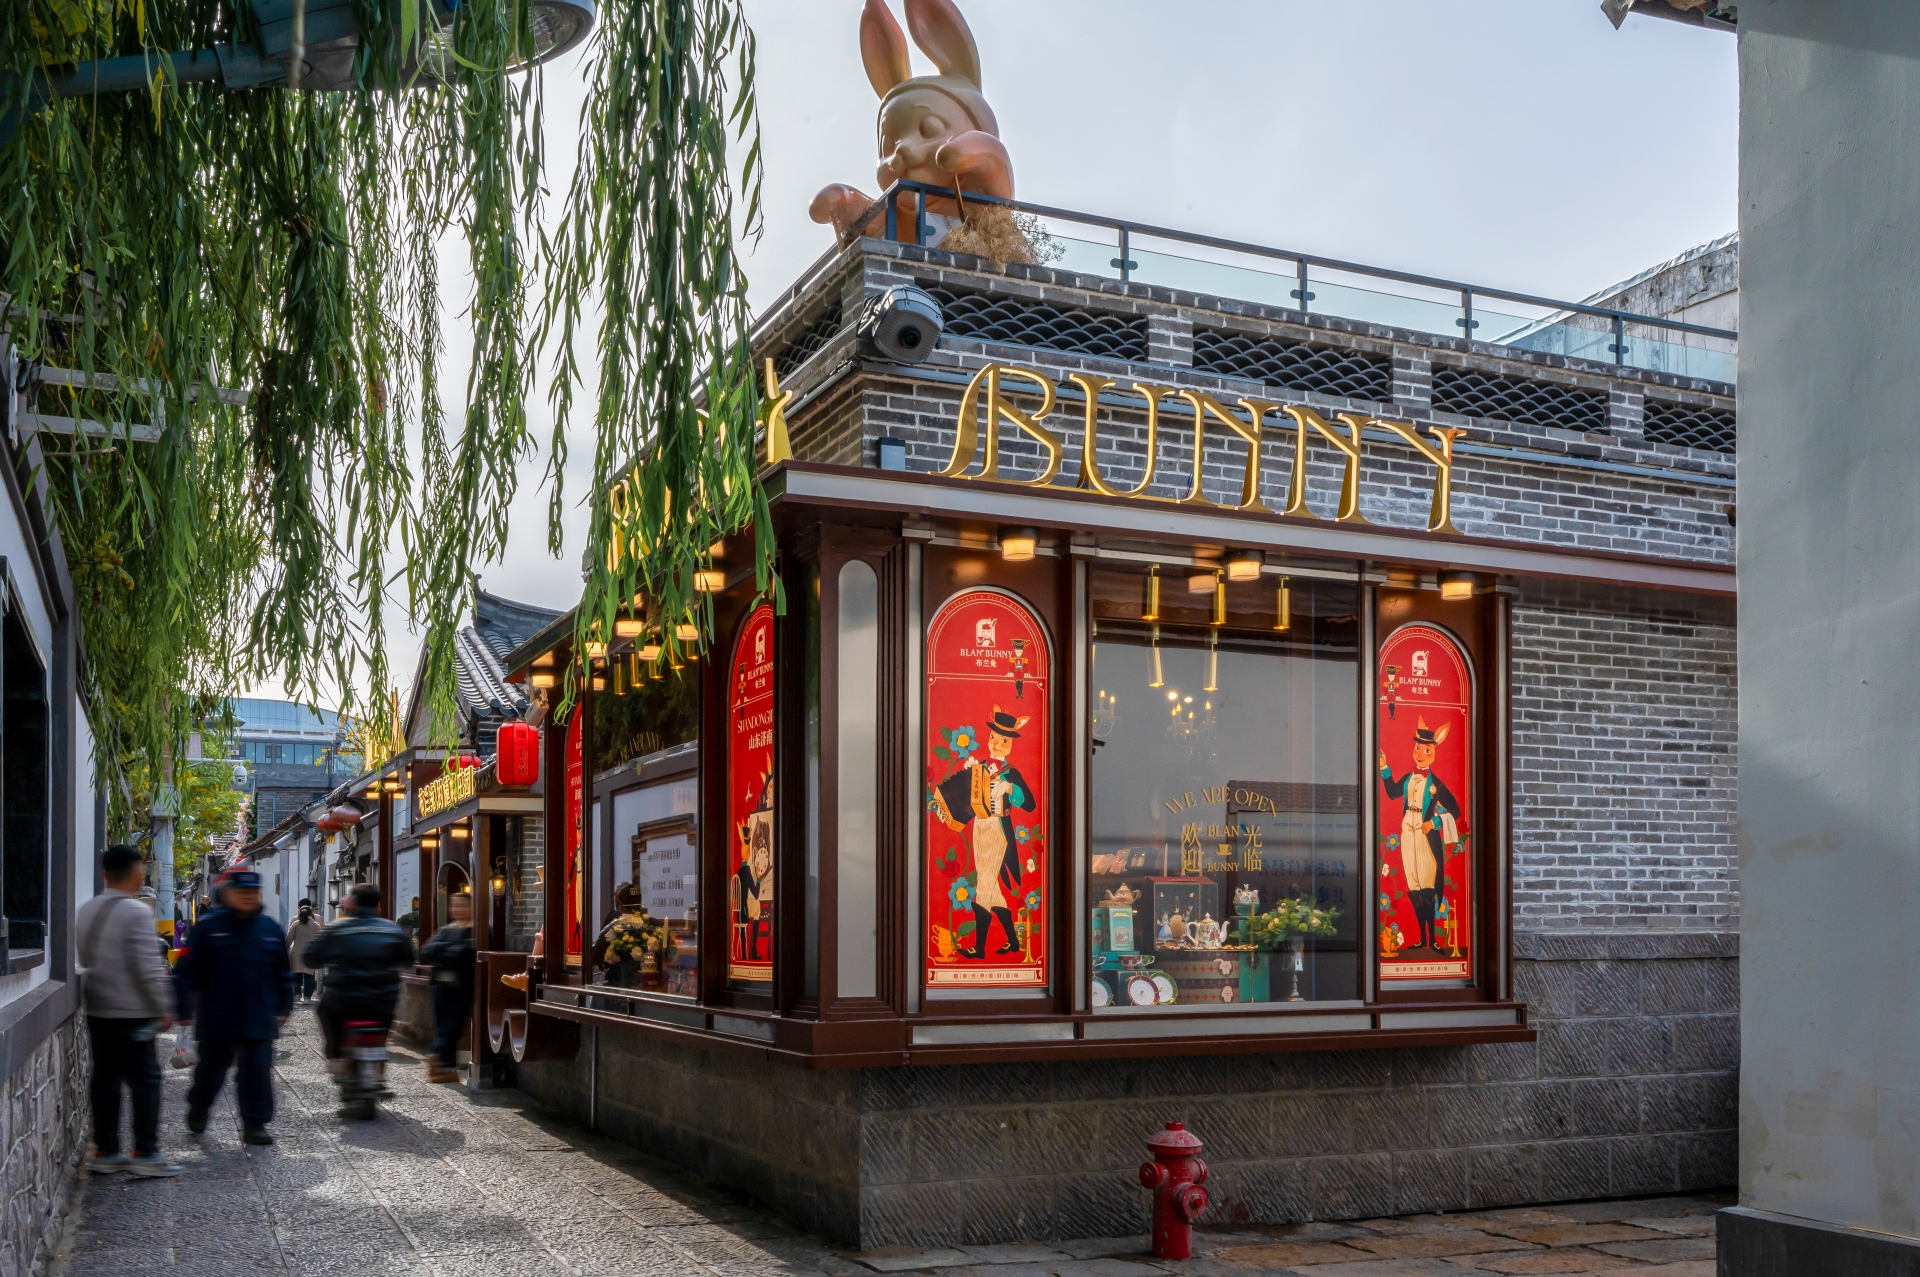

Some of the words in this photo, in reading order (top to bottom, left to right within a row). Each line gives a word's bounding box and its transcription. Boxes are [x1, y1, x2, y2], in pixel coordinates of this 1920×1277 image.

[928, 362, 1467, 535] BUNNY
[985, 649, 1013, 658] BUNNY
[975, 658, 997, 668] 布兰兔
[1418, 678, 1442, 687] BUNNY
[748, 728, 773, 751] 山东济南
[1164, 791, 1198, 815] WE
[1200, 786, 1231, 804] ARE
[1234, 788, 1281, 818] OPEN
[1207, 825, 1240, 837] BLAN
[1243, 825, 1263, 872] 光临
[1207, 862, 1240, 872] BUNNY
